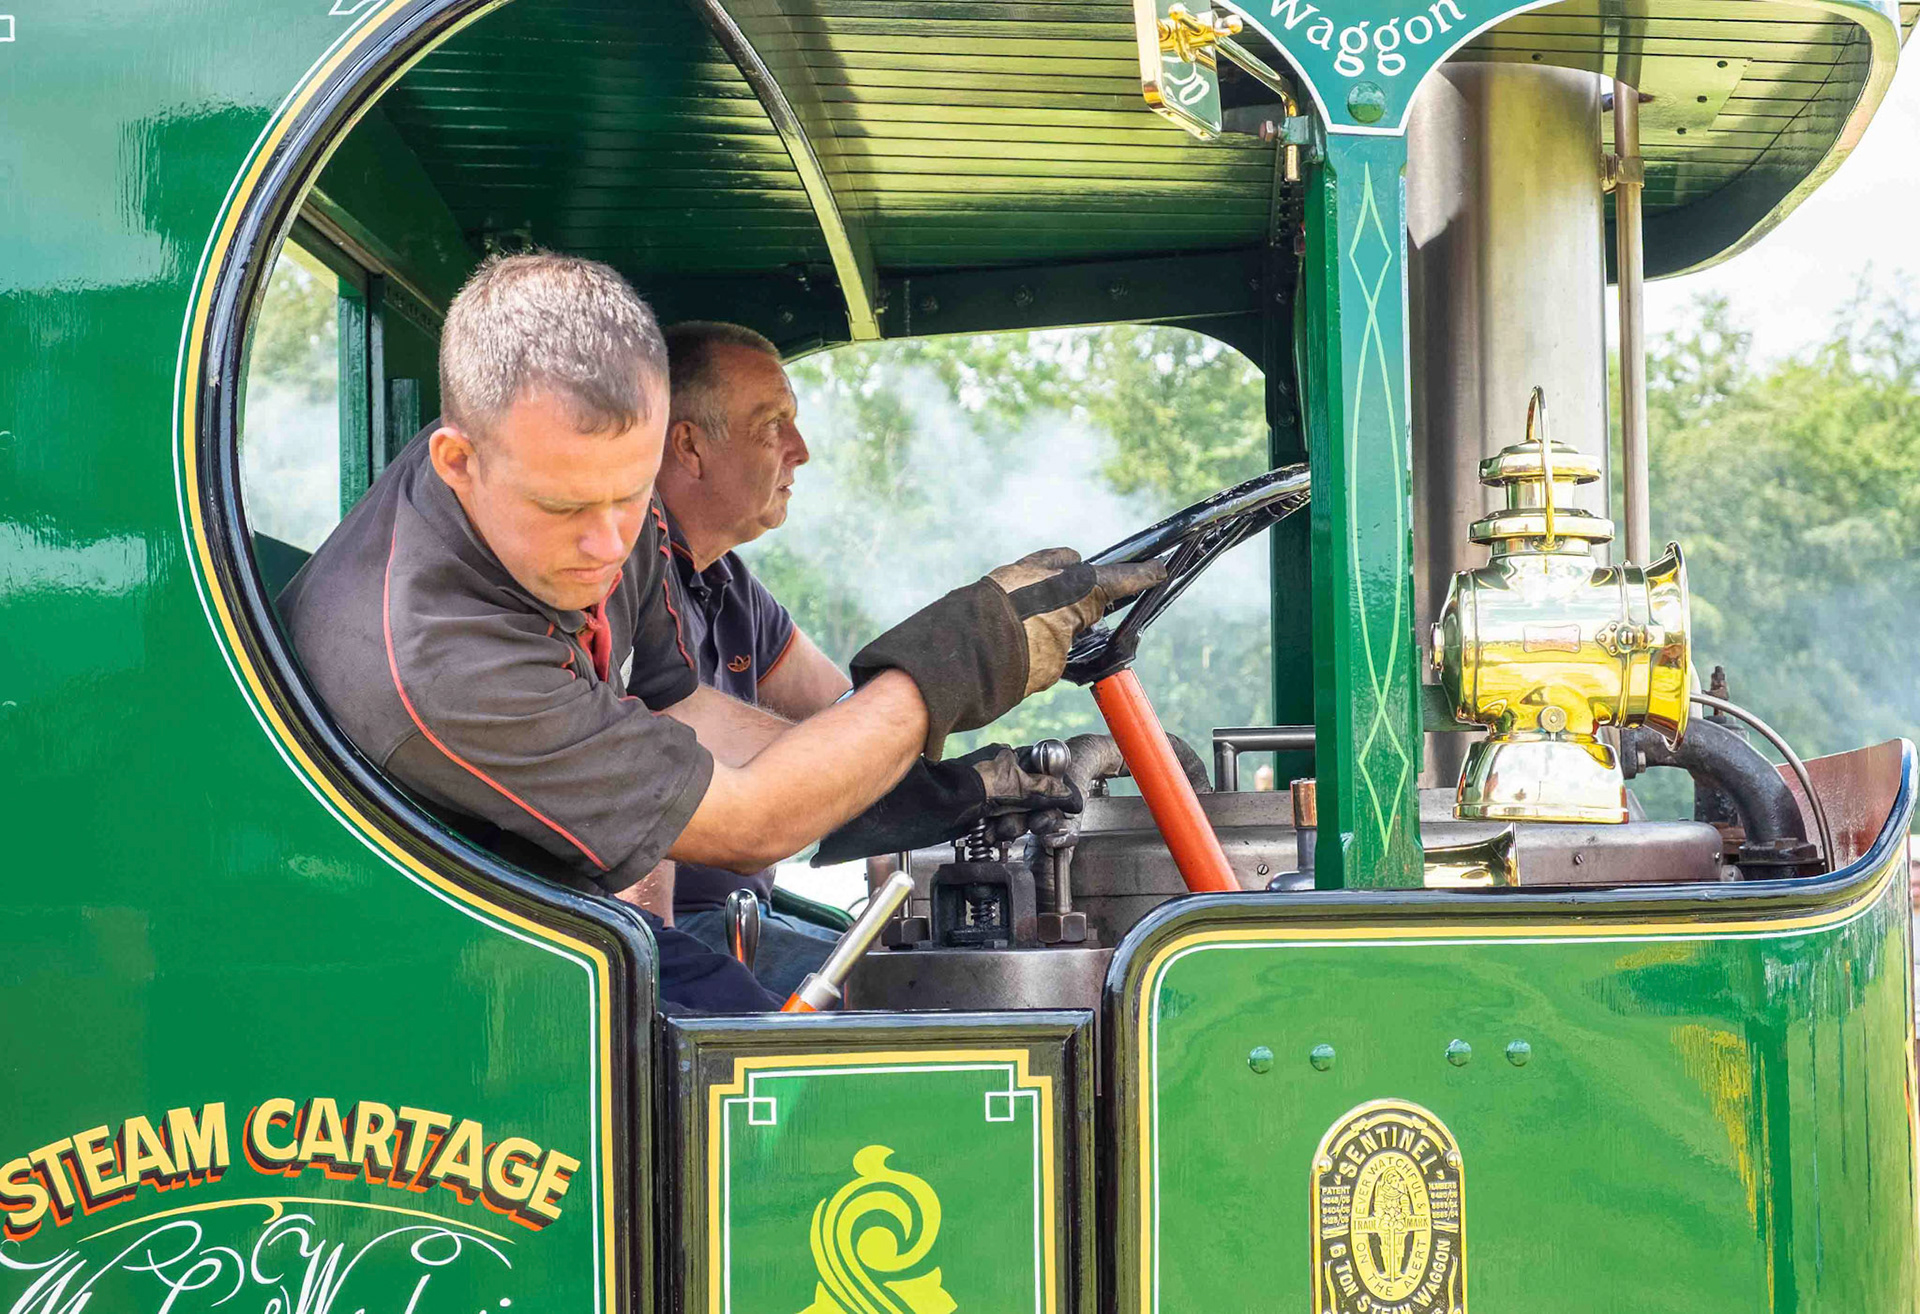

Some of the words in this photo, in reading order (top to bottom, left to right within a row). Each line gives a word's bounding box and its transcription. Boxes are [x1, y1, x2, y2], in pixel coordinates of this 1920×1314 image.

[0, 1102, 230, 1236] STEAM
[246, 1097, 581, 1230] CARTAGE
[1339, 1126, 1437, 1178] SENTINEL
[1321, 1186, 1351, 1195] PATENT
[1356, 1180, 1371, 1214] EVER
[1368, 1156, 1423, 1198] WATCHFUL
[1354, 1219, 1376, 1230] TRADE
[1406, 1217, 1429, 1228] MARK
[1330, 1244, 1347, 1258] 6
[1356, 1242, 1368, 1264] ON
[1368, 1272, 1394, 1297] THE
[1404, 1239, 1426, 1289] ALERT
[1413, 1239, 1451, 1307] WAGGON
[1335, 1260, 1359, 1298] TON
